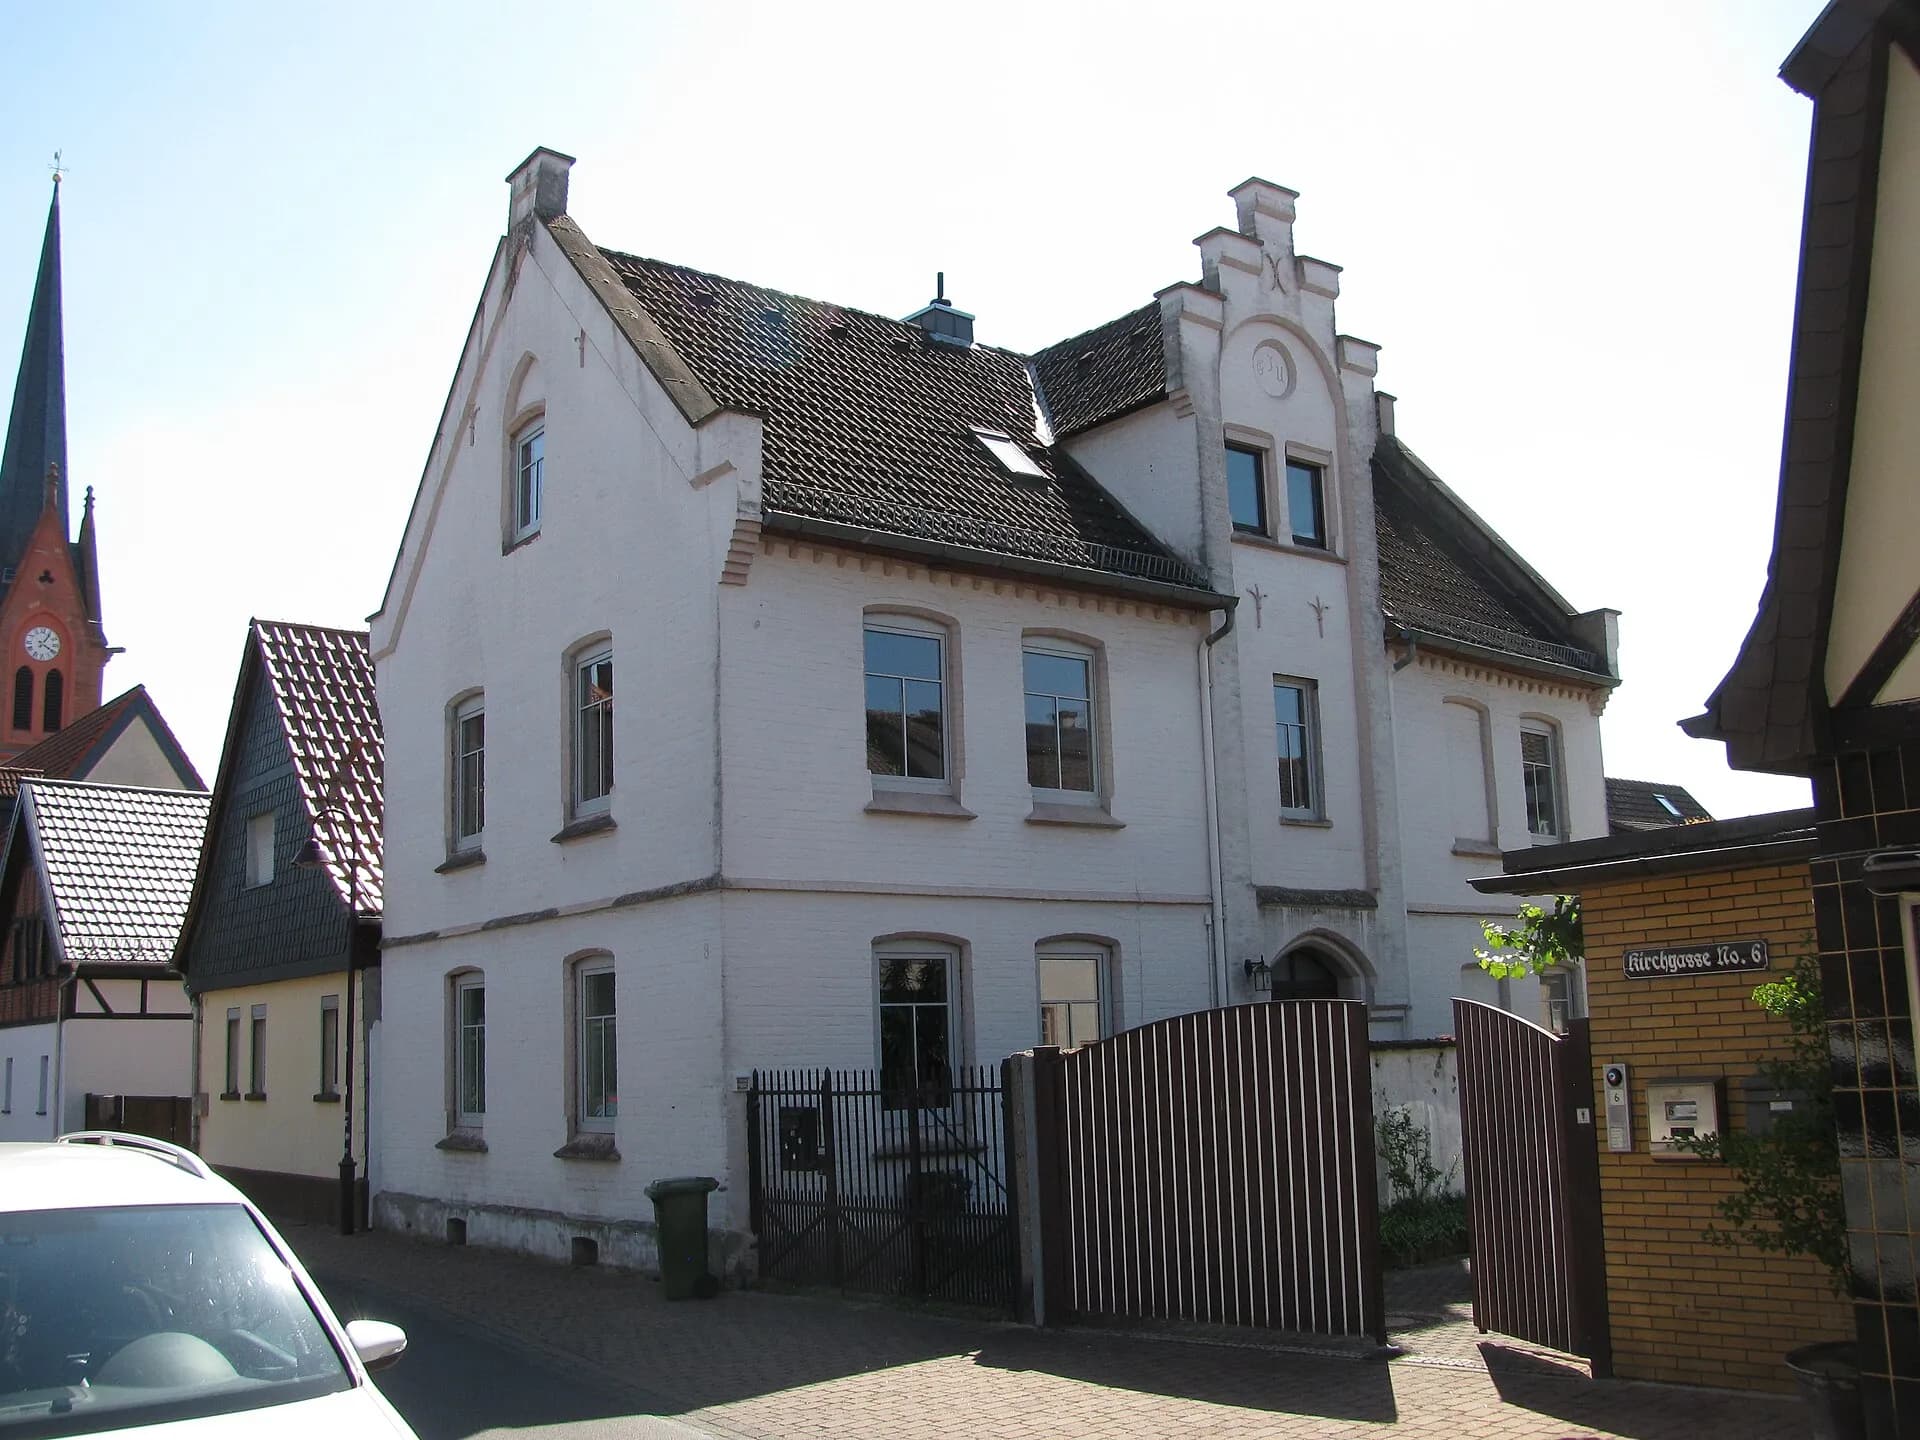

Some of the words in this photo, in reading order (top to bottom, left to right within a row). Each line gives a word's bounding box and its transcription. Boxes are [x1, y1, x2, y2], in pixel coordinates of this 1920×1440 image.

[1628, 951, 1711, 973] Kirchgasse
[1717, 945, 1746, 966] No.
[1751, 944, 1761, 964] 6
[1614, 1093, 1620, 1102] 6
